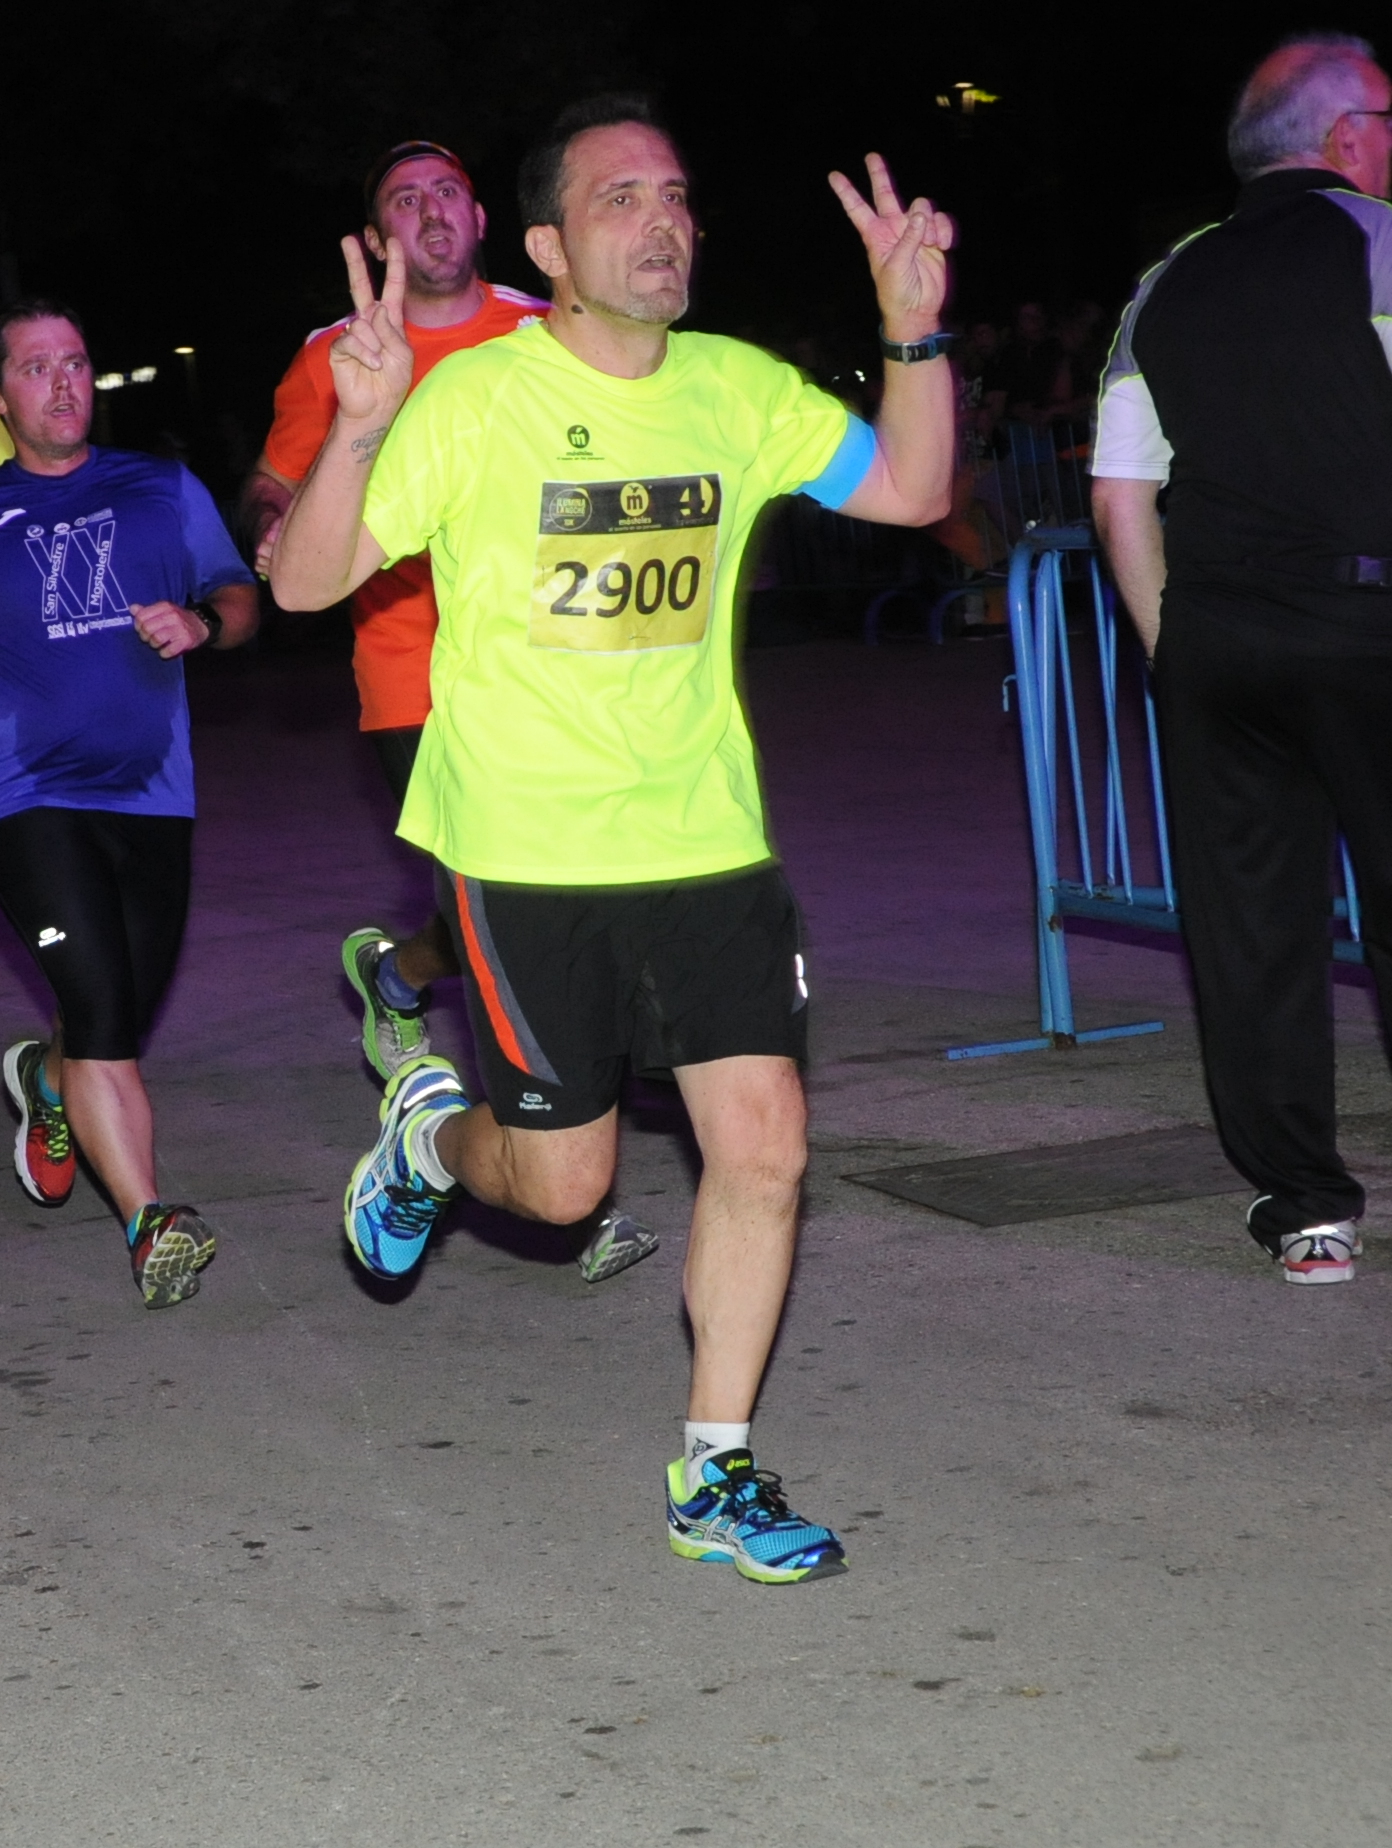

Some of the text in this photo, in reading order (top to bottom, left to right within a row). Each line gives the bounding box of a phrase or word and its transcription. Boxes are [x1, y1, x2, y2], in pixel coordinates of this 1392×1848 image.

[46, 542, 65, 592] Silvestre
[550, 555, 701, 619] 2900
[44, 594, 56, 616] San
